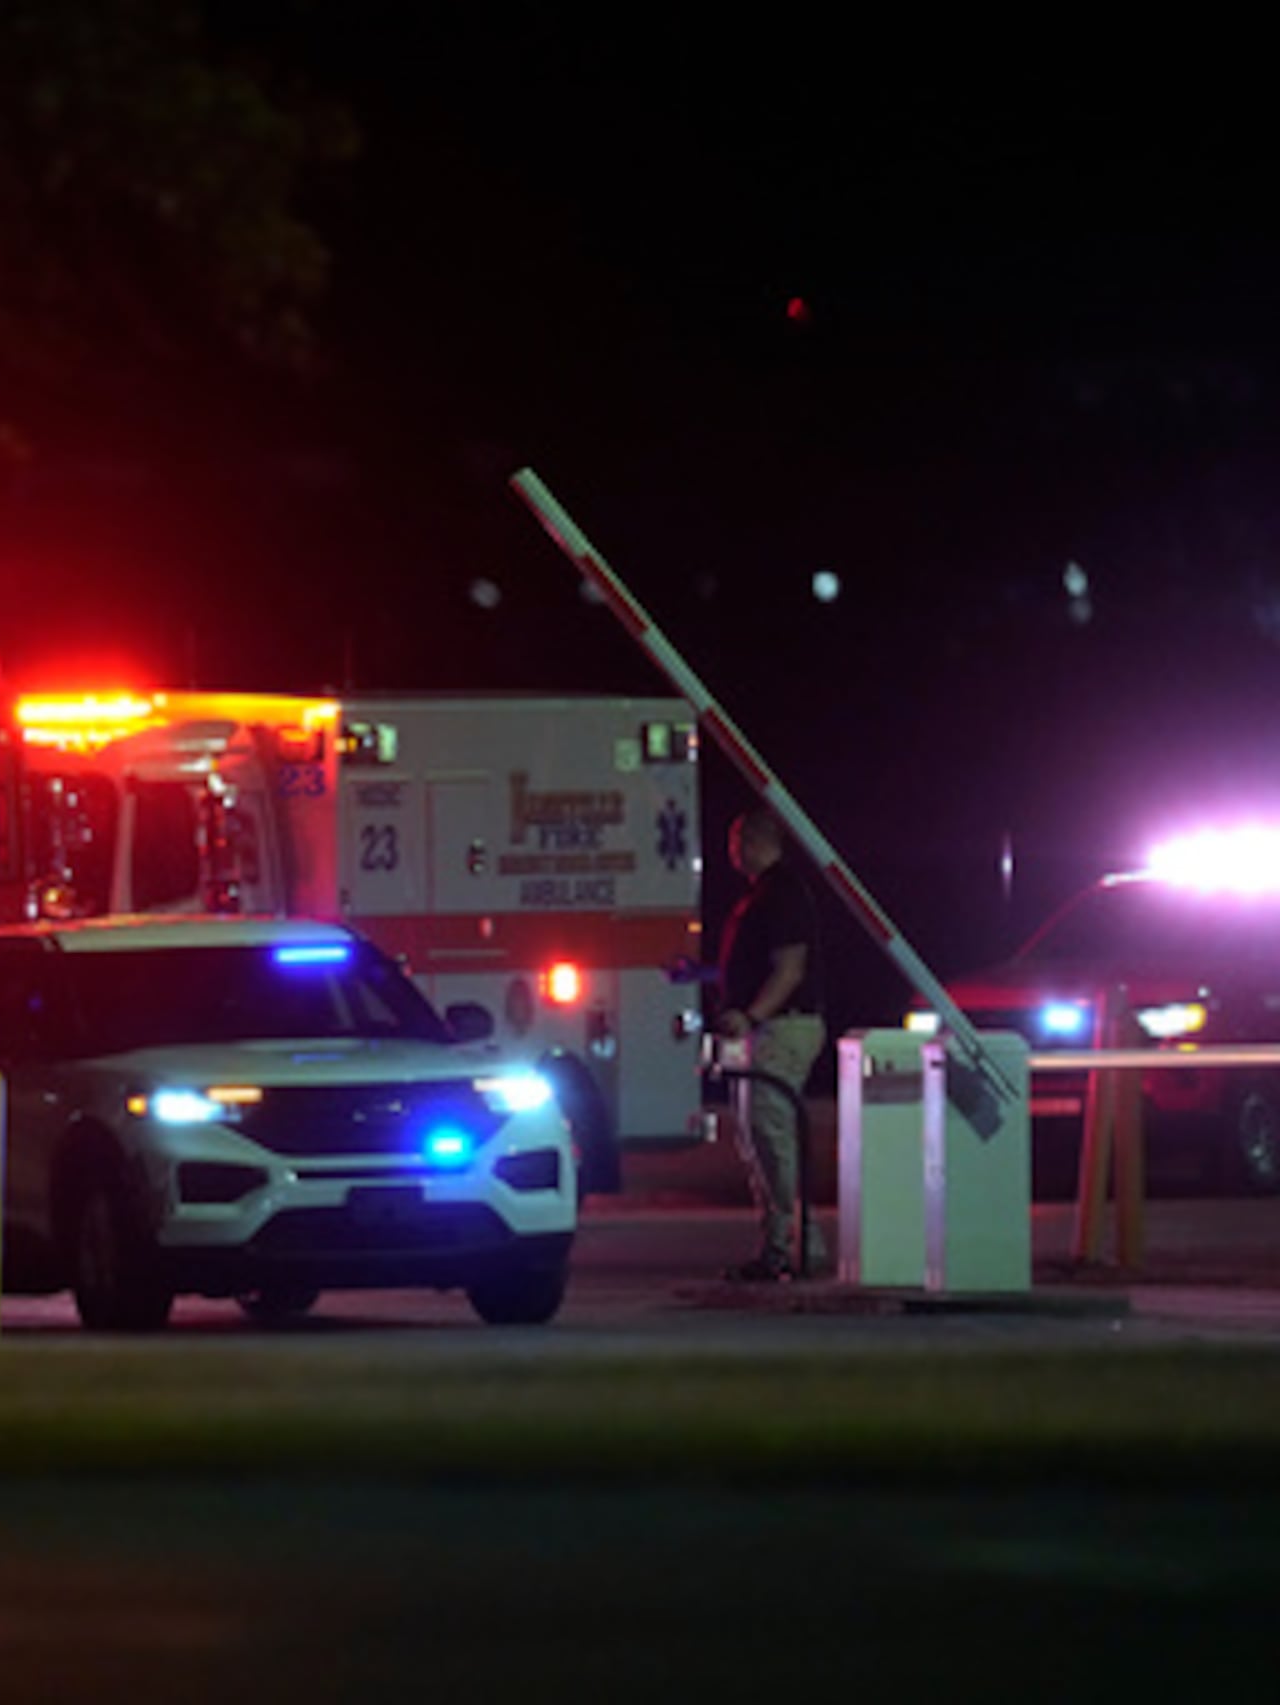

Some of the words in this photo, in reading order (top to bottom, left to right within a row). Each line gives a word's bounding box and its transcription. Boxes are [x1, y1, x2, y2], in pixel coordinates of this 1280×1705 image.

[278, 766, 325, 798] 23
[361, 823, 399, 871] 23
[520, 879, 616, 905] AMBULANCE
